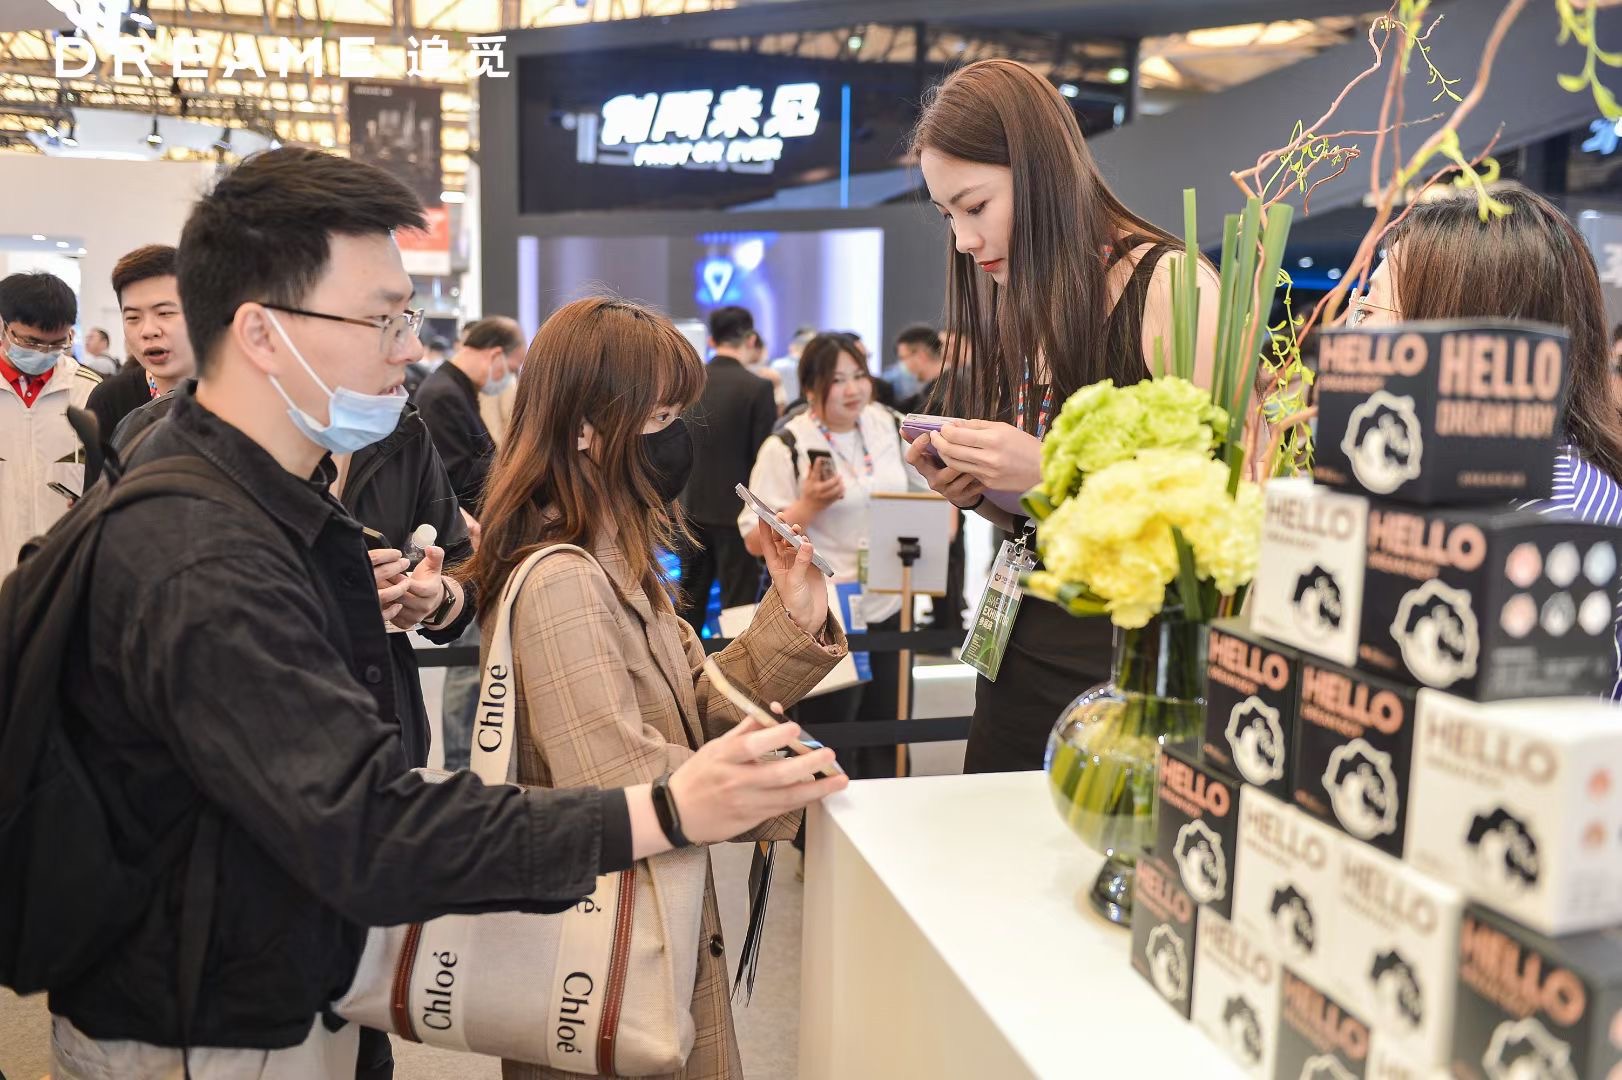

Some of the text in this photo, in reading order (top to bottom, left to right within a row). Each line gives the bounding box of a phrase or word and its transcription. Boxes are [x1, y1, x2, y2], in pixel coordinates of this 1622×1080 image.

[1318, 333, 1428, 377] HELLO
[1438, 333, 1562, 400] HELLO
[1266, 493, 1356, 540] HELLO
[1368, 511, 1487, 571] HELLO
[1208, 630, 1289, 691] HELLO
[477, 664, 508, 753] Chloé
[1303, 665, 1404, 735] HELLO
[1427, 713, 1558, 785] HELLO
[1160, 754, 1230, 817] HELLO
[1246, 809, 1327, 870] HELLO
[1137, 857, 1193, 924] HELLO
[1343, 856, 1438, 936] HELLO
[1203, 918, 1272, 984] HELLO
[1461, 915, 1587, 1027] HELLO
[422, 951, 458, 1031] Chloé
[556, 971, 594, 1054] Chloé
[1284, 972, 1369, 1060] HELLO
